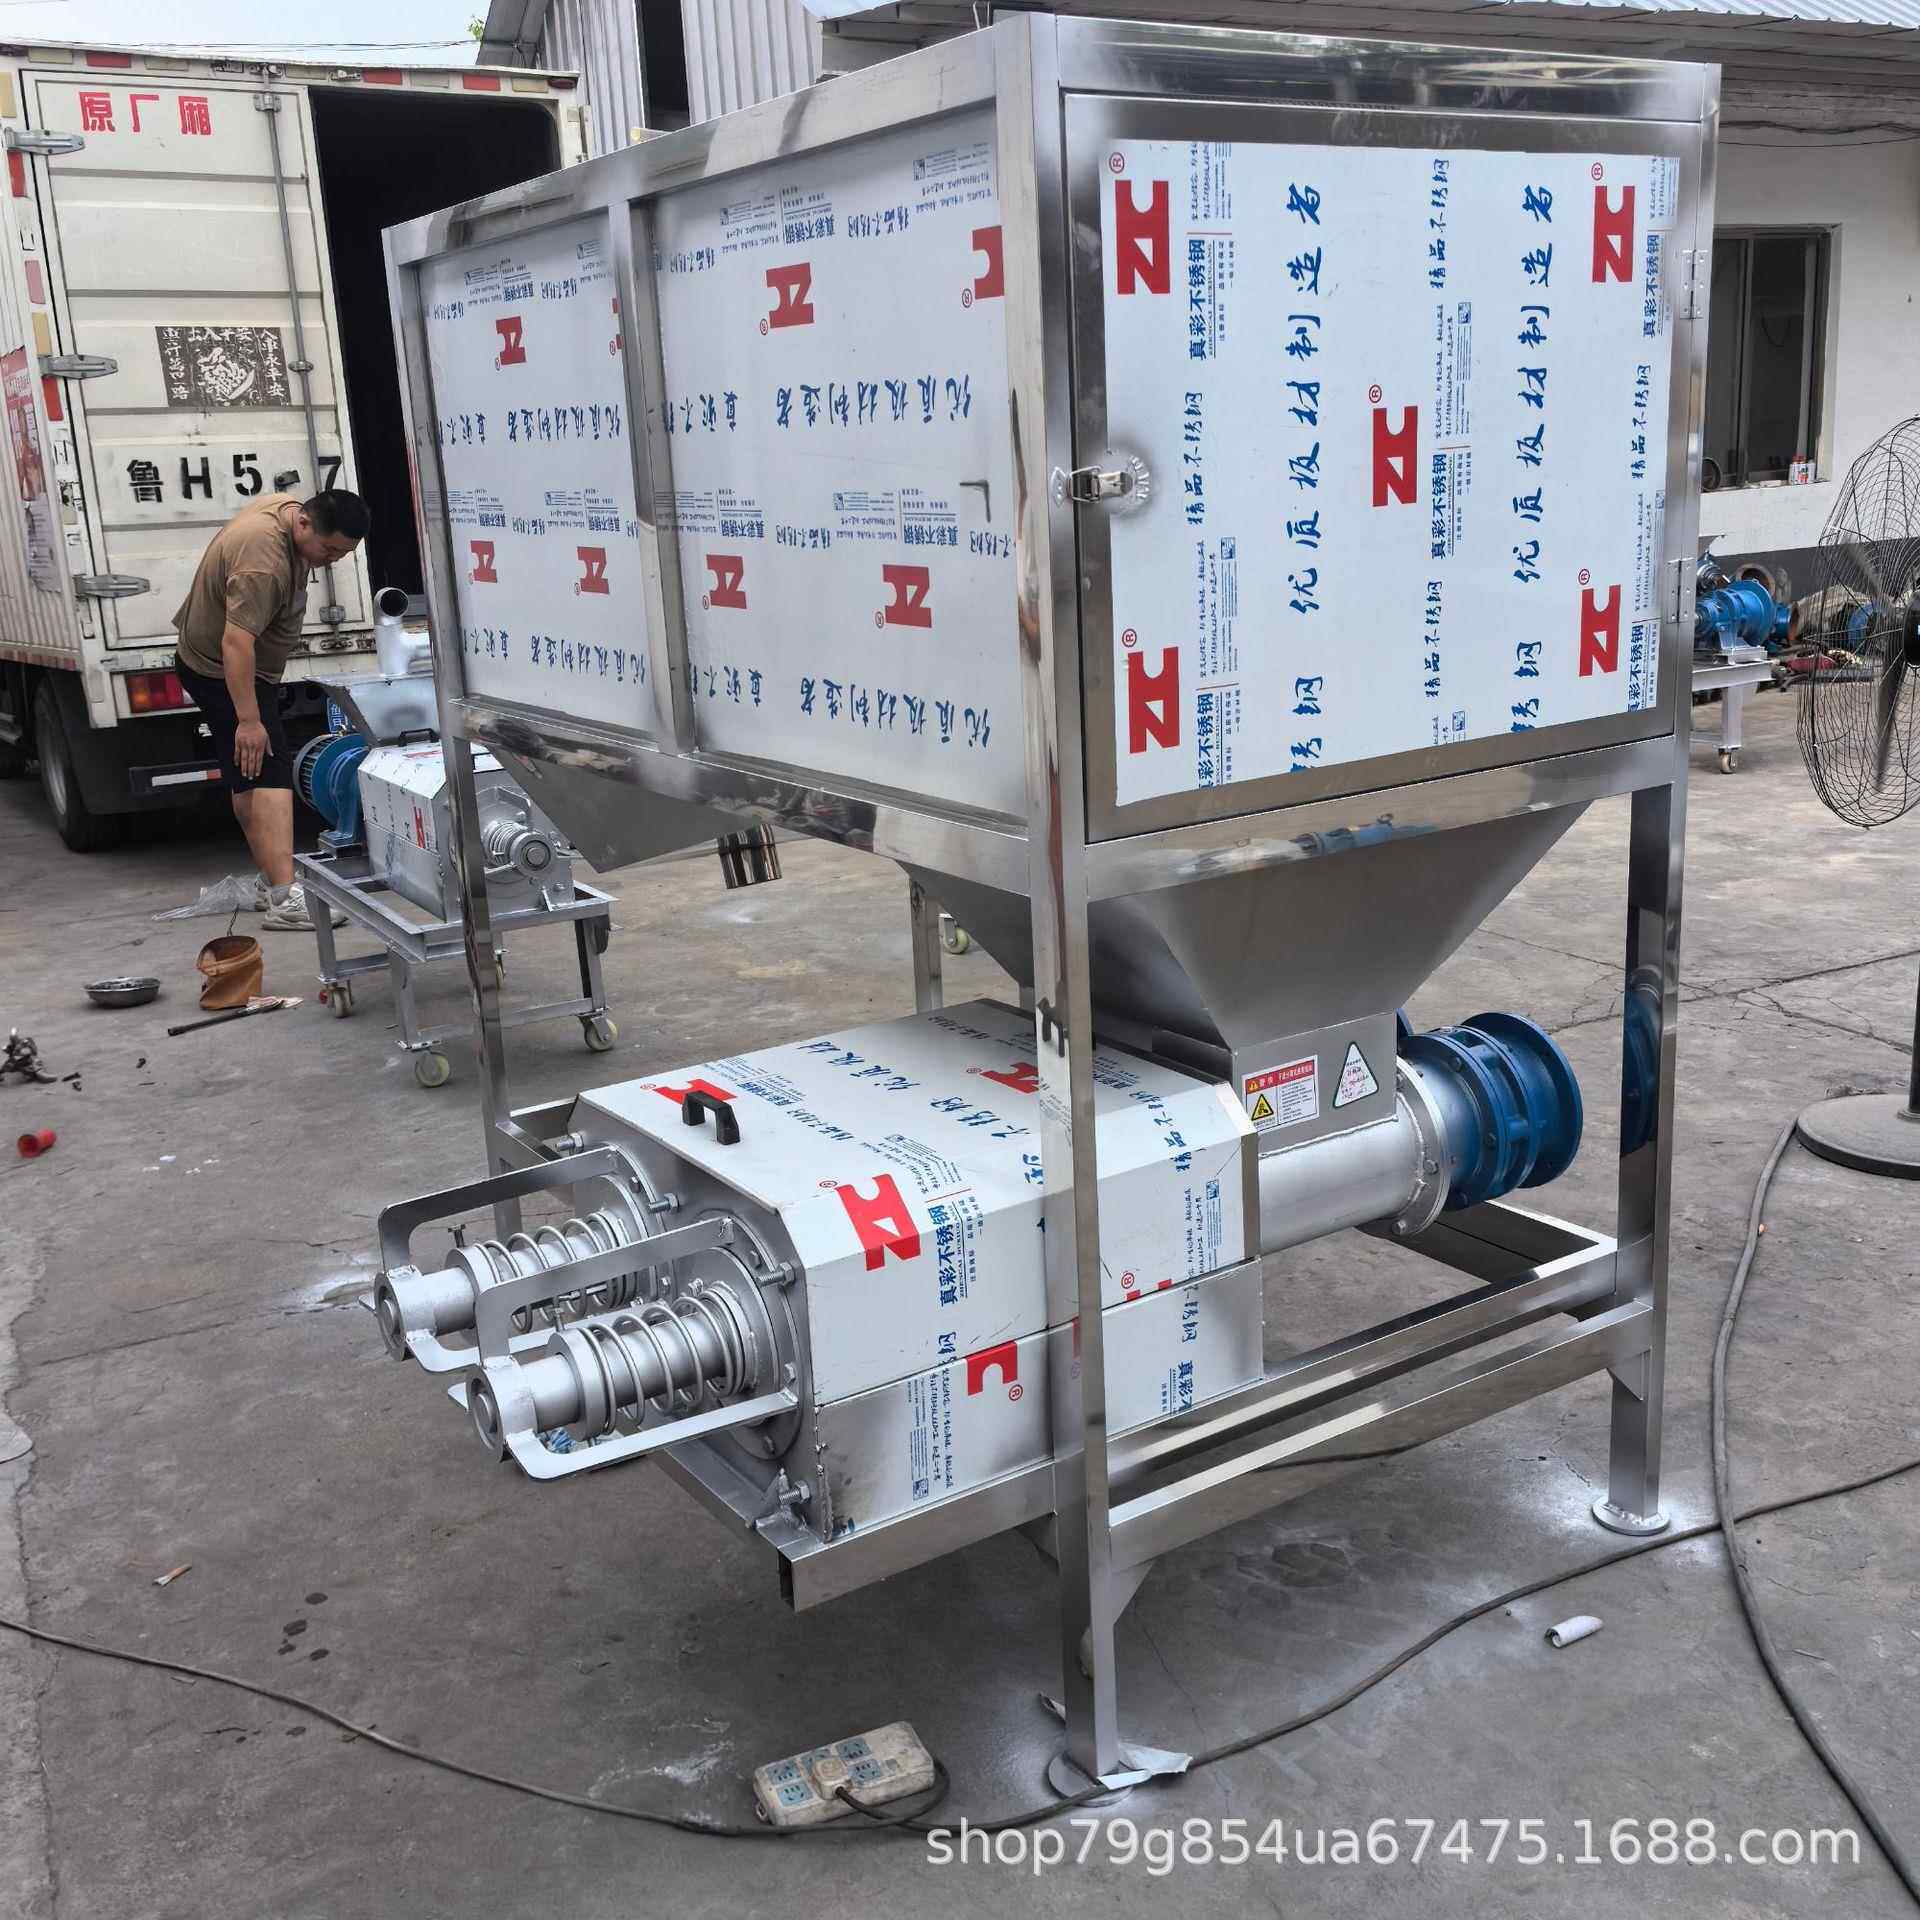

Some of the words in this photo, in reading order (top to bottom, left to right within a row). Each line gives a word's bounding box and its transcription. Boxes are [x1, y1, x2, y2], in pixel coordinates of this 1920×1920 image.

[79, 91, 214, 136] 原厂厢
[1188, 239, 1206, 360] 真彩不锈钢
[904, 524, 959, 546] 真彩不锈钢
[1431, 453, 1447, 559] 真彩不锈钢
[928, 1204, 958, 1307] 真彩不锈钢
